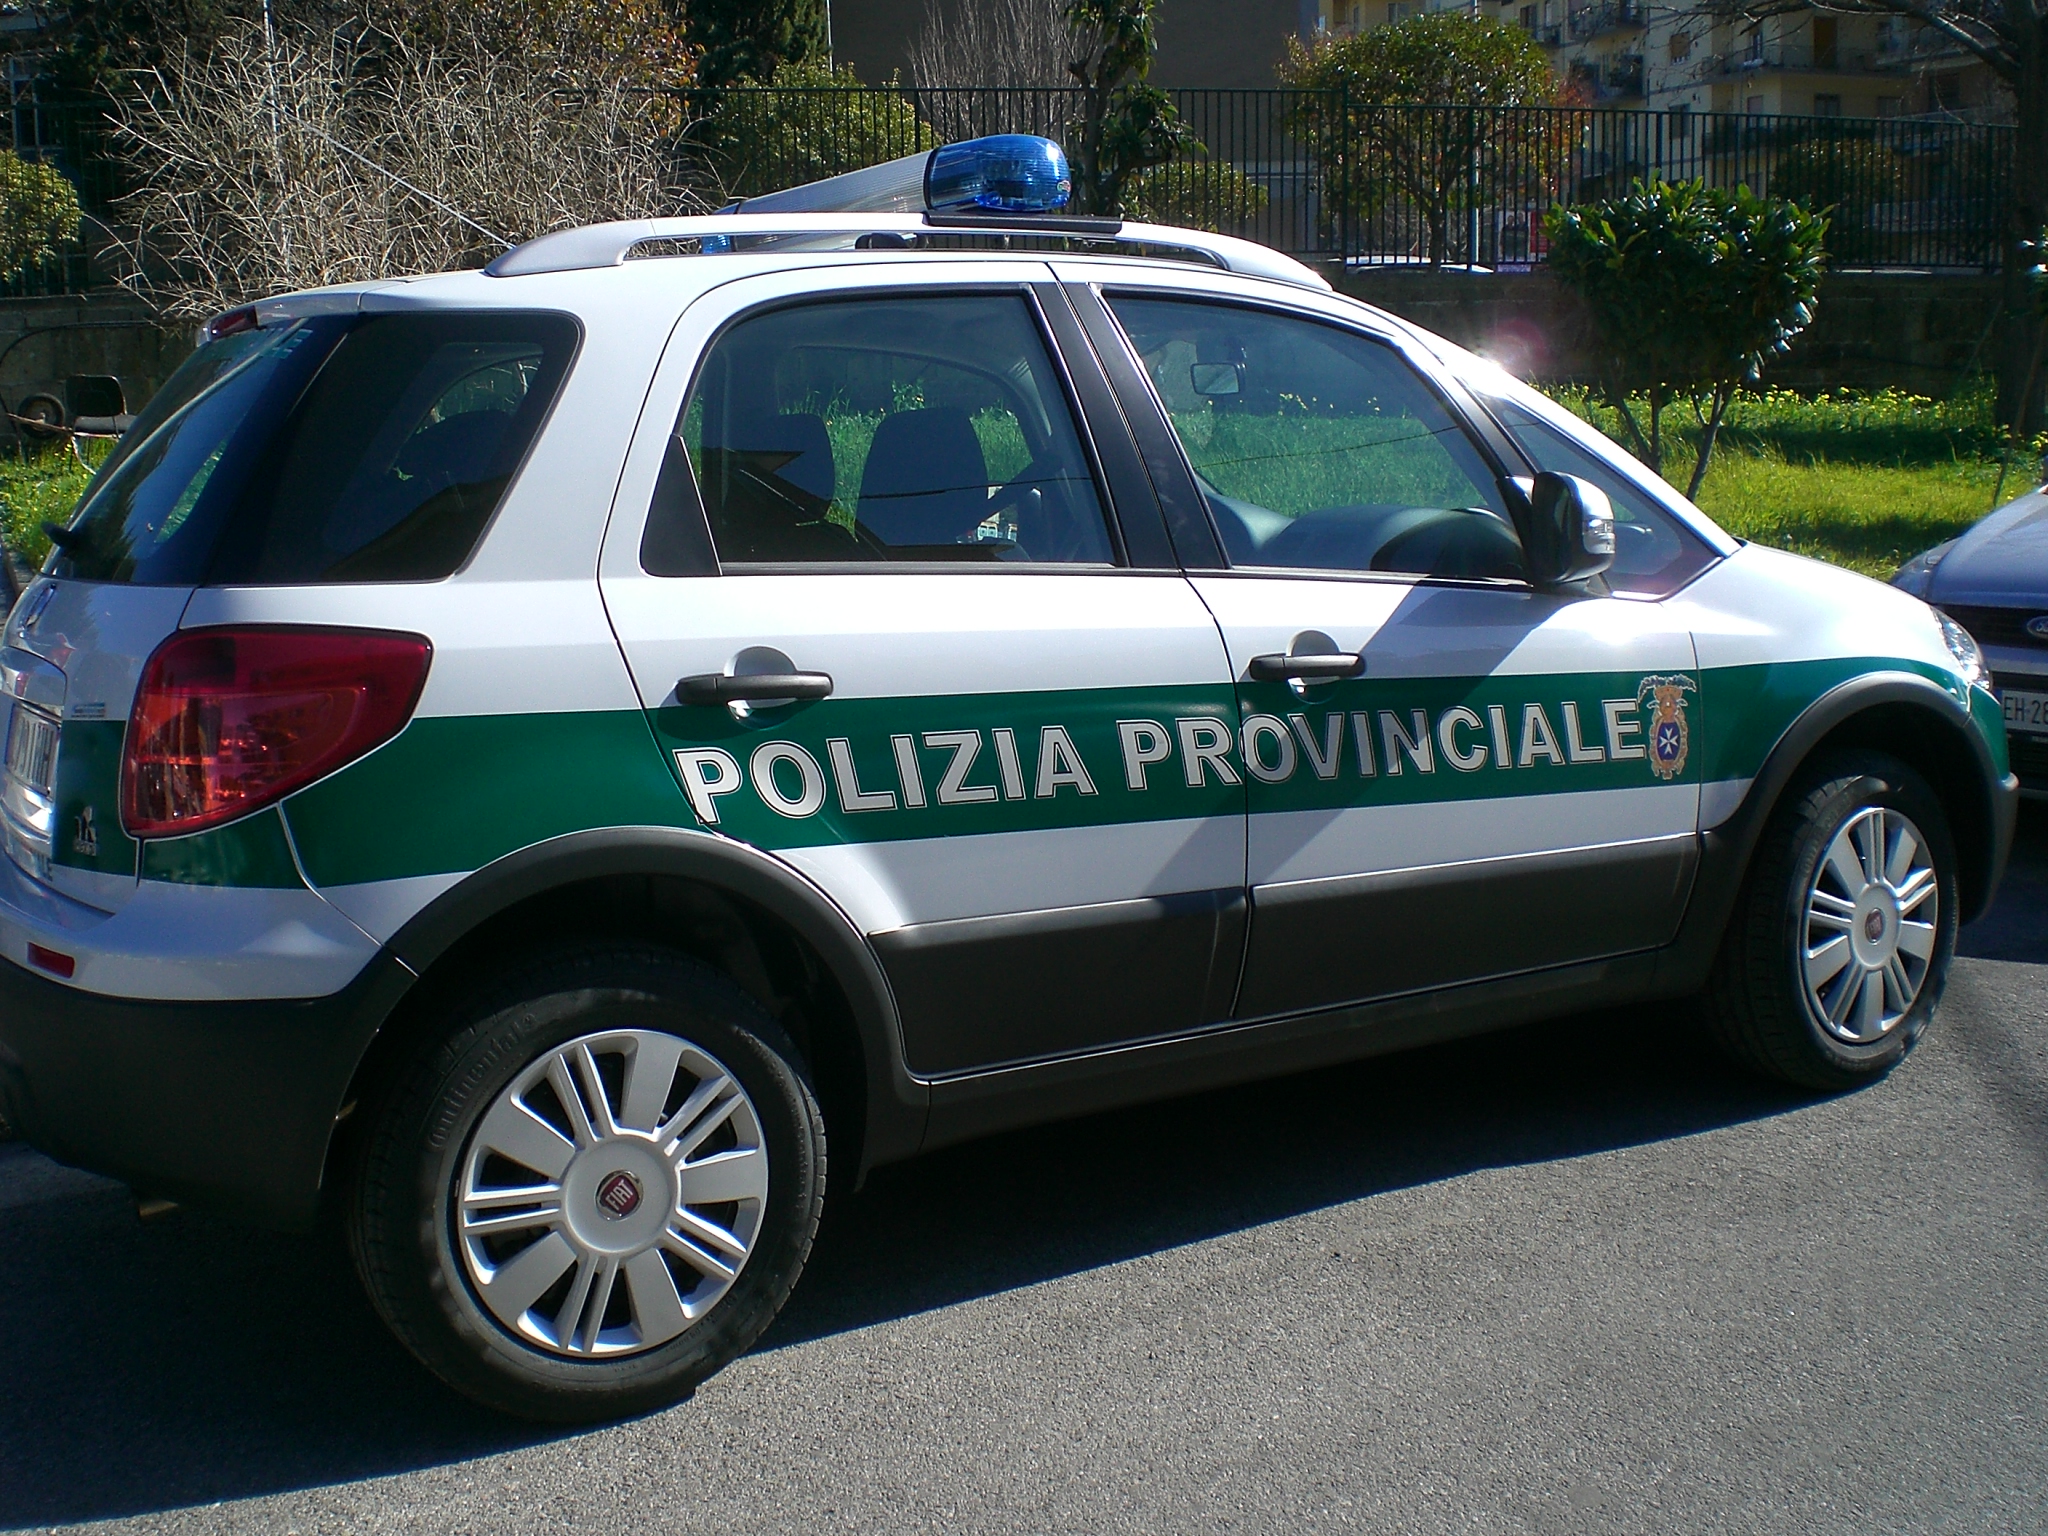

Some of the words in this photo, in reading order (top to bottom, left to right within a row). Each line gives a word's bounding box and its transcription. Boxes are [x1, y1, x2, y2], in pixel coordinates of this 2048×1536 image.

[2003, 696, 2025, 722] EH
[672, 725, 1099, 824] POLIZIA
[1116, 699, 1647, 791] PROVINCIALE
[605, 1179, 633, 1211] FIAT
